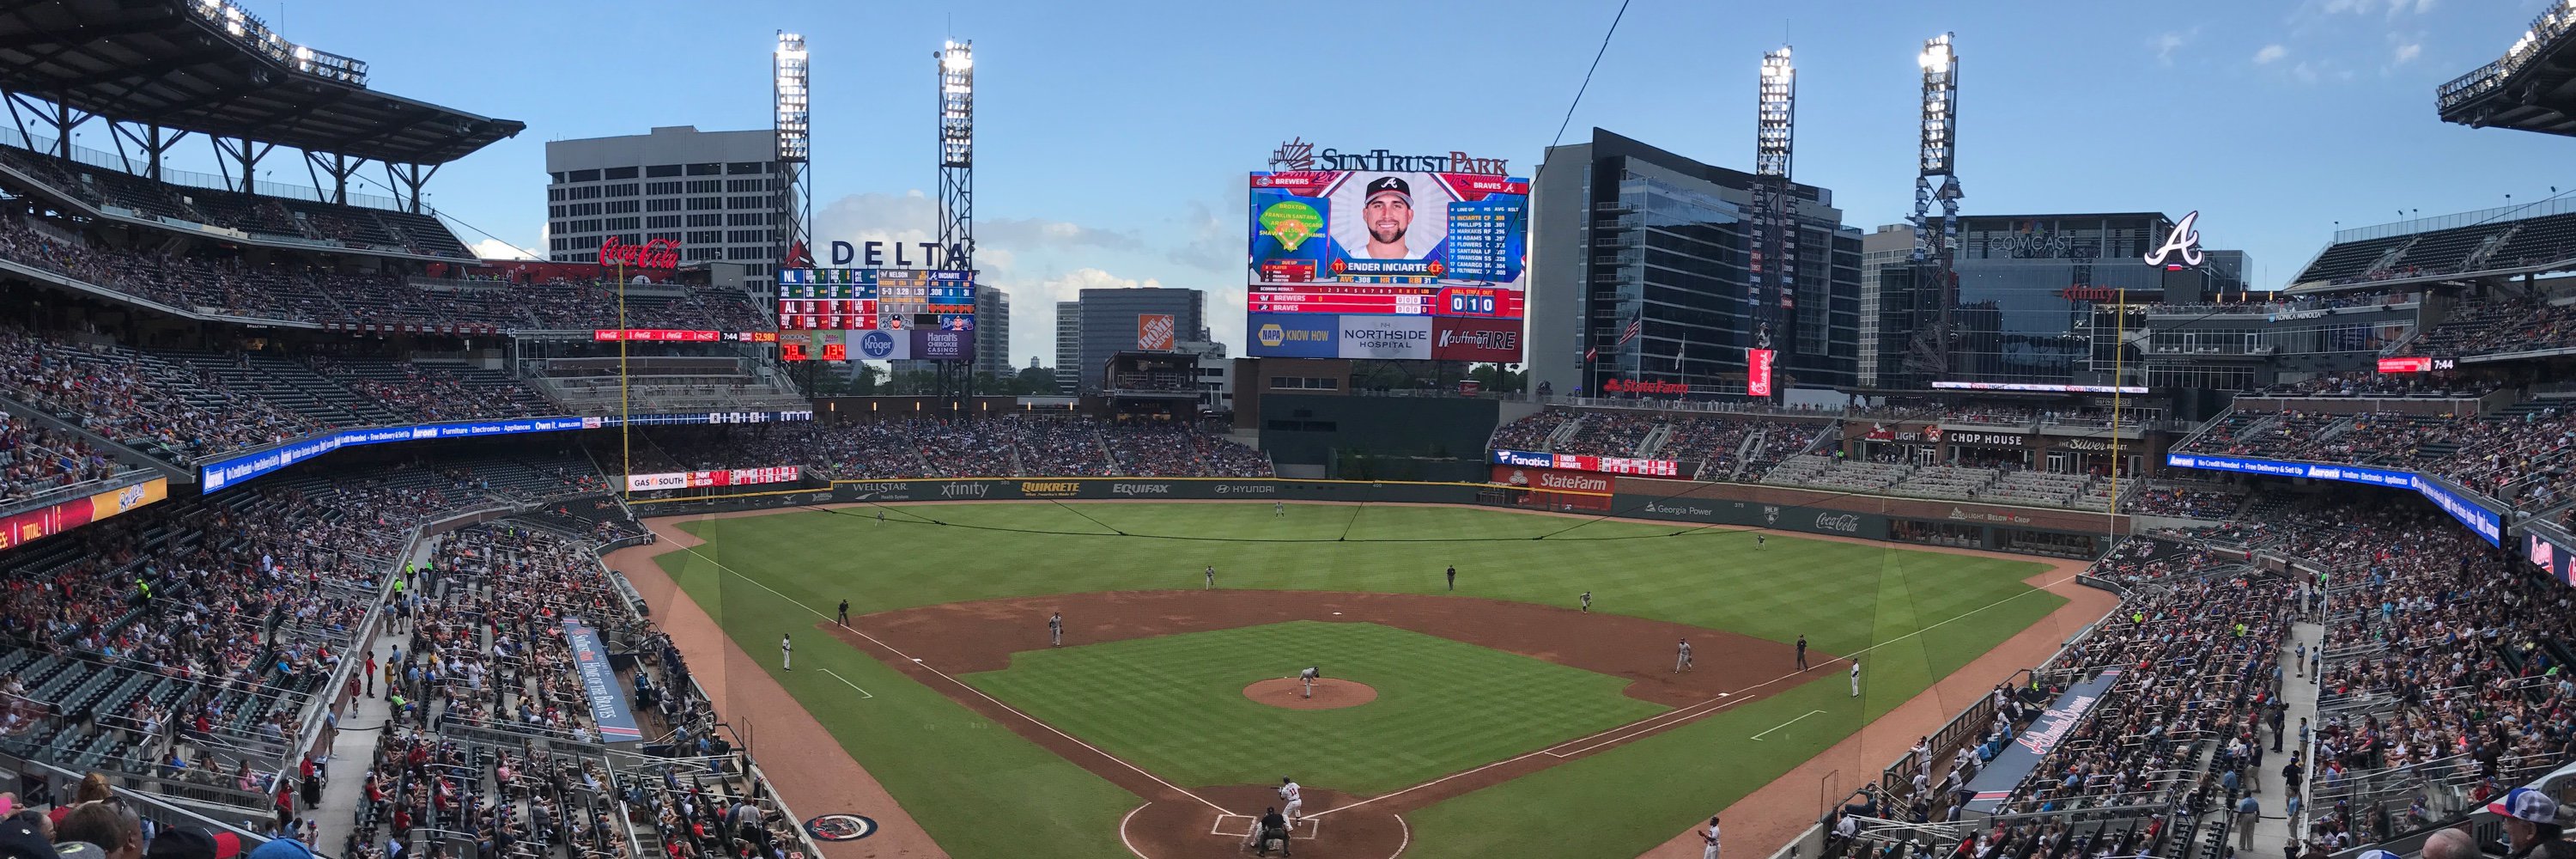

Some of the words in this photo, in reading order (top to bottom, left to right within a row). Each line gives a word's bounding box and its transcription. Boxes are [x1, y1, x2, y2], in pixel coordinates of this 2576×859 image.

[1449, 151, 1510, 177] PARK
[1473, 181, 1501, 190] BRAVES
[1990, 235, 2075, 250] COMCAST
[598, 235, 683, 269] Coca-Cola
[831, 241, 969, 271] DELTA
[1334, 262, 1344, 271] 11
[1347, 262, 1381, 271] ENDER
[1382, 263, 1427, 272] INCIARTE
[1431, 264, 1443, 272] CF
[784, 271, 797, 283] NL
[882, 287, 892, 295] 5-3
[2062, 283, 2117, 303] xfinity
[785, 301, 798, 314] AL
[884, 304, 890, 313] 0
[1453, 297, 1462, 310] 0
[1469, 298, 1477, 310] 1
[1483, 299, 1493, 311] 0
[2275, 313, 2296, 321] KONICA
[2296, 311, 2321, 320] MINOLTA
[1142, 318, 1158, 332] THE
[506, 327, 515, 338] 42
[724, 332, 738, 341] 7:44
[754, 332, 776, 342] $2,980
[927, 332, 958, 342] Harrah's
[1139, 314, 1175, 350] HOME
[1151, 327, 1175, 350] DEPOT
[1261, 330, 1280, 341] NAPA
[1286, 330, 1310, 341] KNOW
[1311, 330, 1329, 342] HOW
[1344, 329, 1427, 340] NORTHSIDE
[864, 335, 892, 355] Kroger
[1437, 329, 1488, 348] Kauffman
[1475, 331, 1516, 350] TIRE
[784, 345, 799, 356] 79
[827, 345, 846, 356] 134
[2433, 359, 2454, 369] 7:44
[1622, 379, 1689, 394] StateFarm
[471, 425, 501, 434] Electronics
[503, 423, 532, 433] Appliances
[535, 421, 550, 430] Own
[1895, 432, 1921, 441] LIGHT
[1951, 432, 1981, 443] CHOP
[1984, 435, 2022, 446] HOUSE
[2069, 438, 2106, 451] Silver
[1511, 454, 1550, 467] Fanatics
[2170, 455, 2195, 467] Aaron's
[2205, 460, 2220, 468] Credit
[2221, 460, 2240, 469] Needed
[2257, 464, 2280, 473] Delivery
[2294, 466, 2304, 475] Up
[1540, 473, 1607, 490] StateFarm
[2307, 465, 2341, 478] Aaron's
[2342, 470, 2359, 479] Furniture
[2360, 472, 2383, 483] Electronics
[2385, 475, 2408, 485] Appliances
[634, 478, 650, 487] GAS
[659, 477, 683, 485] SOUTH
[853, 483, 908, 492] WELLSTAR
[1022, 482, 1080, 492] QUIKRETE
[941, 482, 989, 498] xfinity
[1113, 484, 1170, 496] EQUIFAX
[1657, 504, 1687, 515] Georgia
[1689, 506, 1713, 516] Power
[1815, 512, 1861, 533] Coca-Cola
[22, 522, 41, 542] TOTAL:
[582, 661, 601, 678] HOME
[591, 684, 608, 696] THE
[594, 695, 617, 719] BRAVES
[1289, 788, 1297, 796] 11
